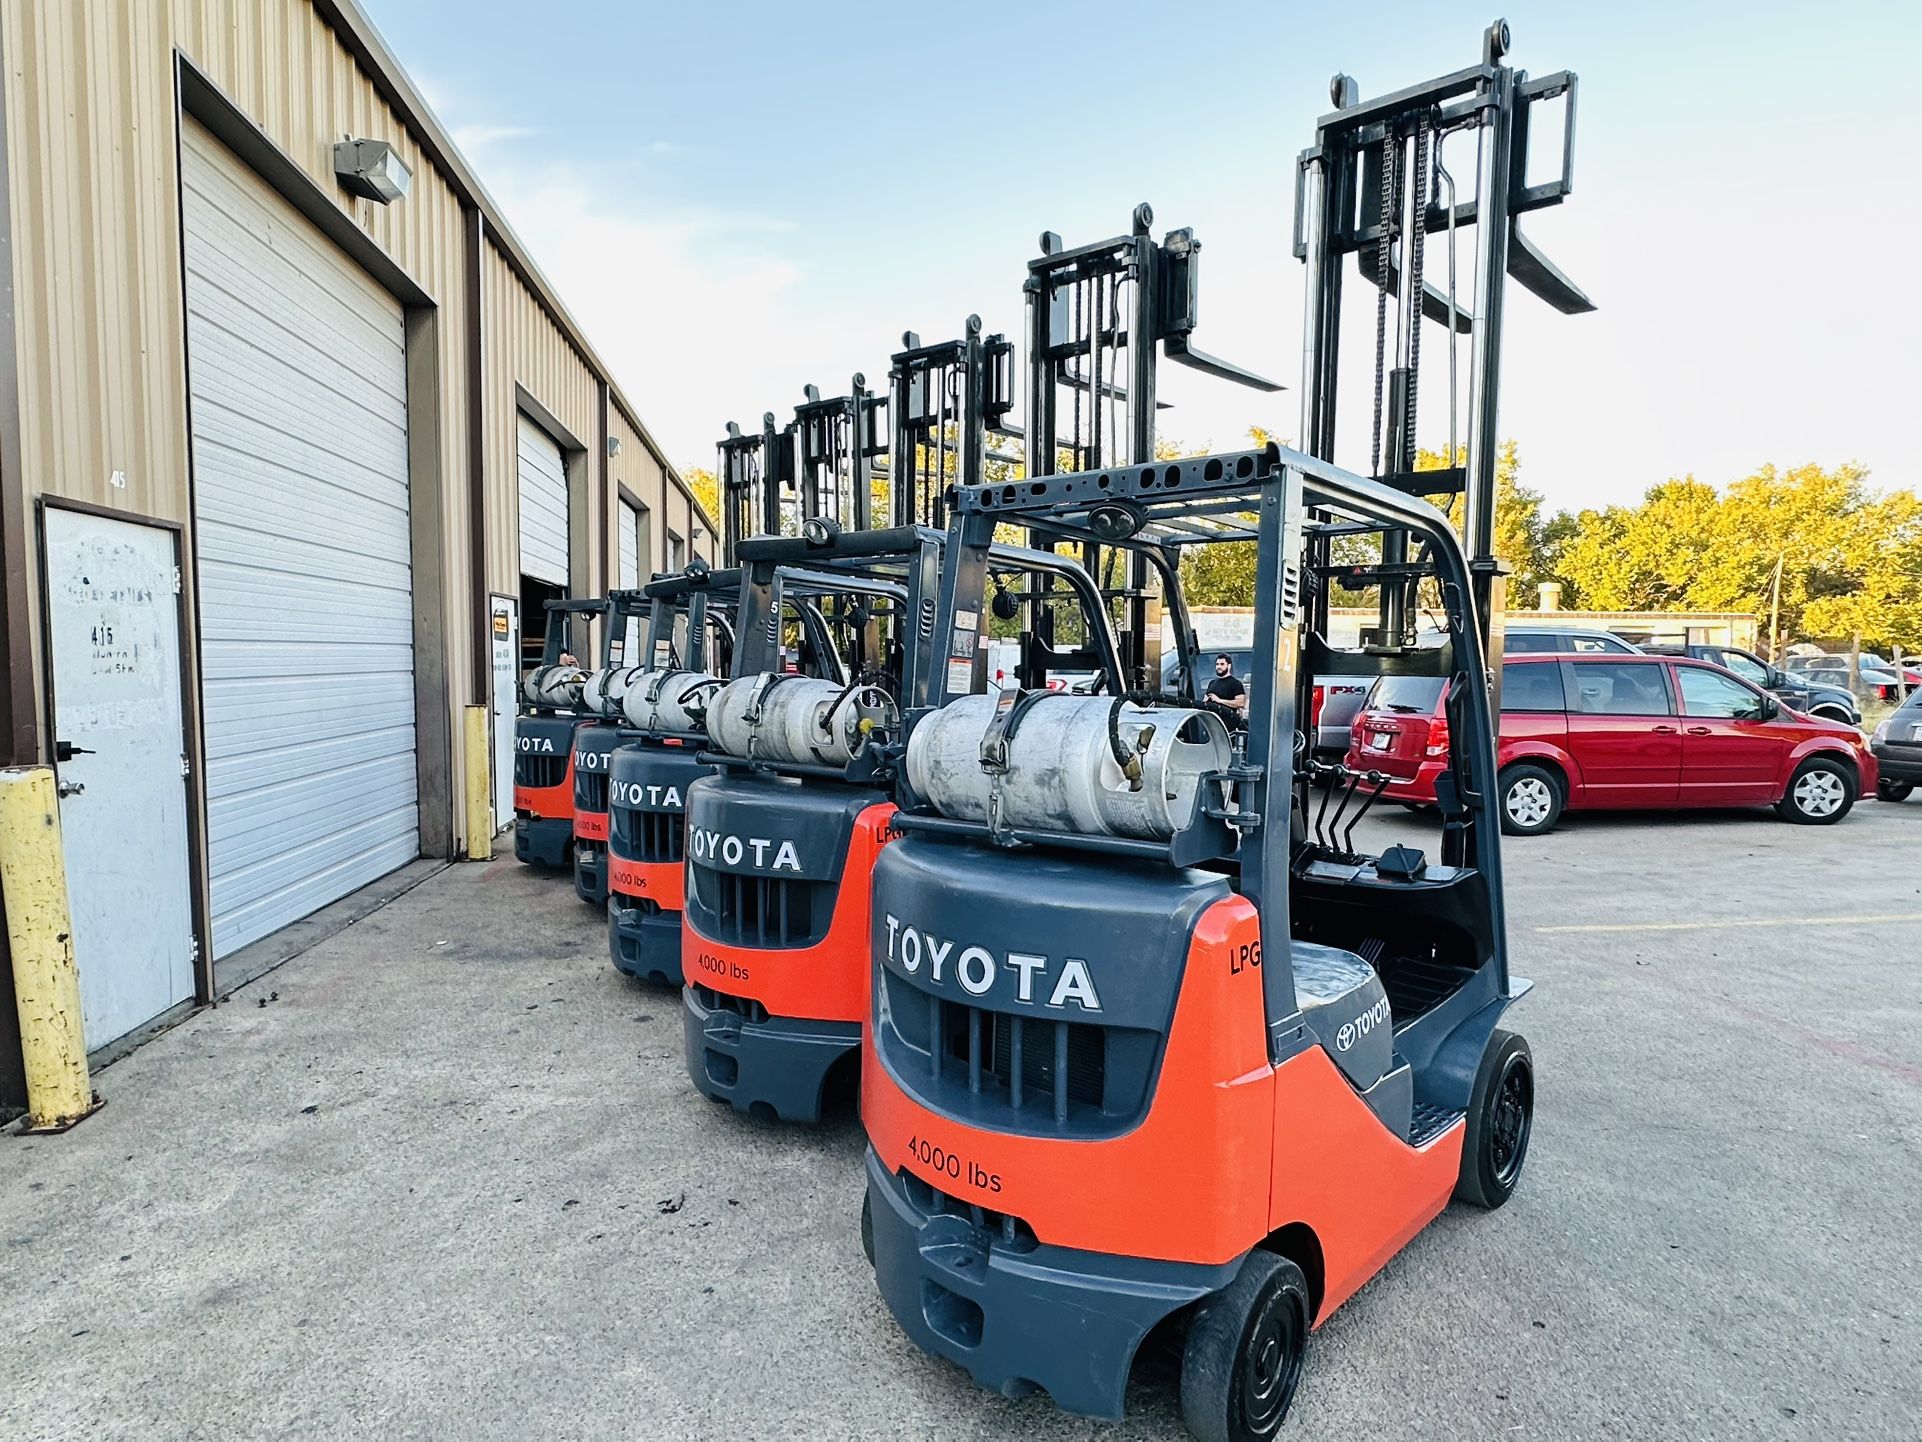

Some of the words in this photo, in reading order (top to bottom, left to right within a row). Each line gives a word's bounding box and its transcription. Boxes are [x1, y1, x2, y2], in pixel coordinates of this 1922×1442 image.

[110, 470, 125, 488] 415
[770, 601, 779, 614] 5
[1330, 685, 1366, 695] FX4
[515, 736, 554, 752] YOTA
[575, 750, 612, 769] OYOT
[689, 823, 801, 871] TOYOTA
[634, 874, 647, 888] lbs
[886, 913, 1101, 1011] TOYOTA
[1230, 940, 1261, 976] LPG
[730, 962, 749, 980] lbs
[1355, 994, 1391, 1039] TOYOTA
[908, 1135, 960, 1179] 4,000
[968, 1161, 1002, 1193] lbs
